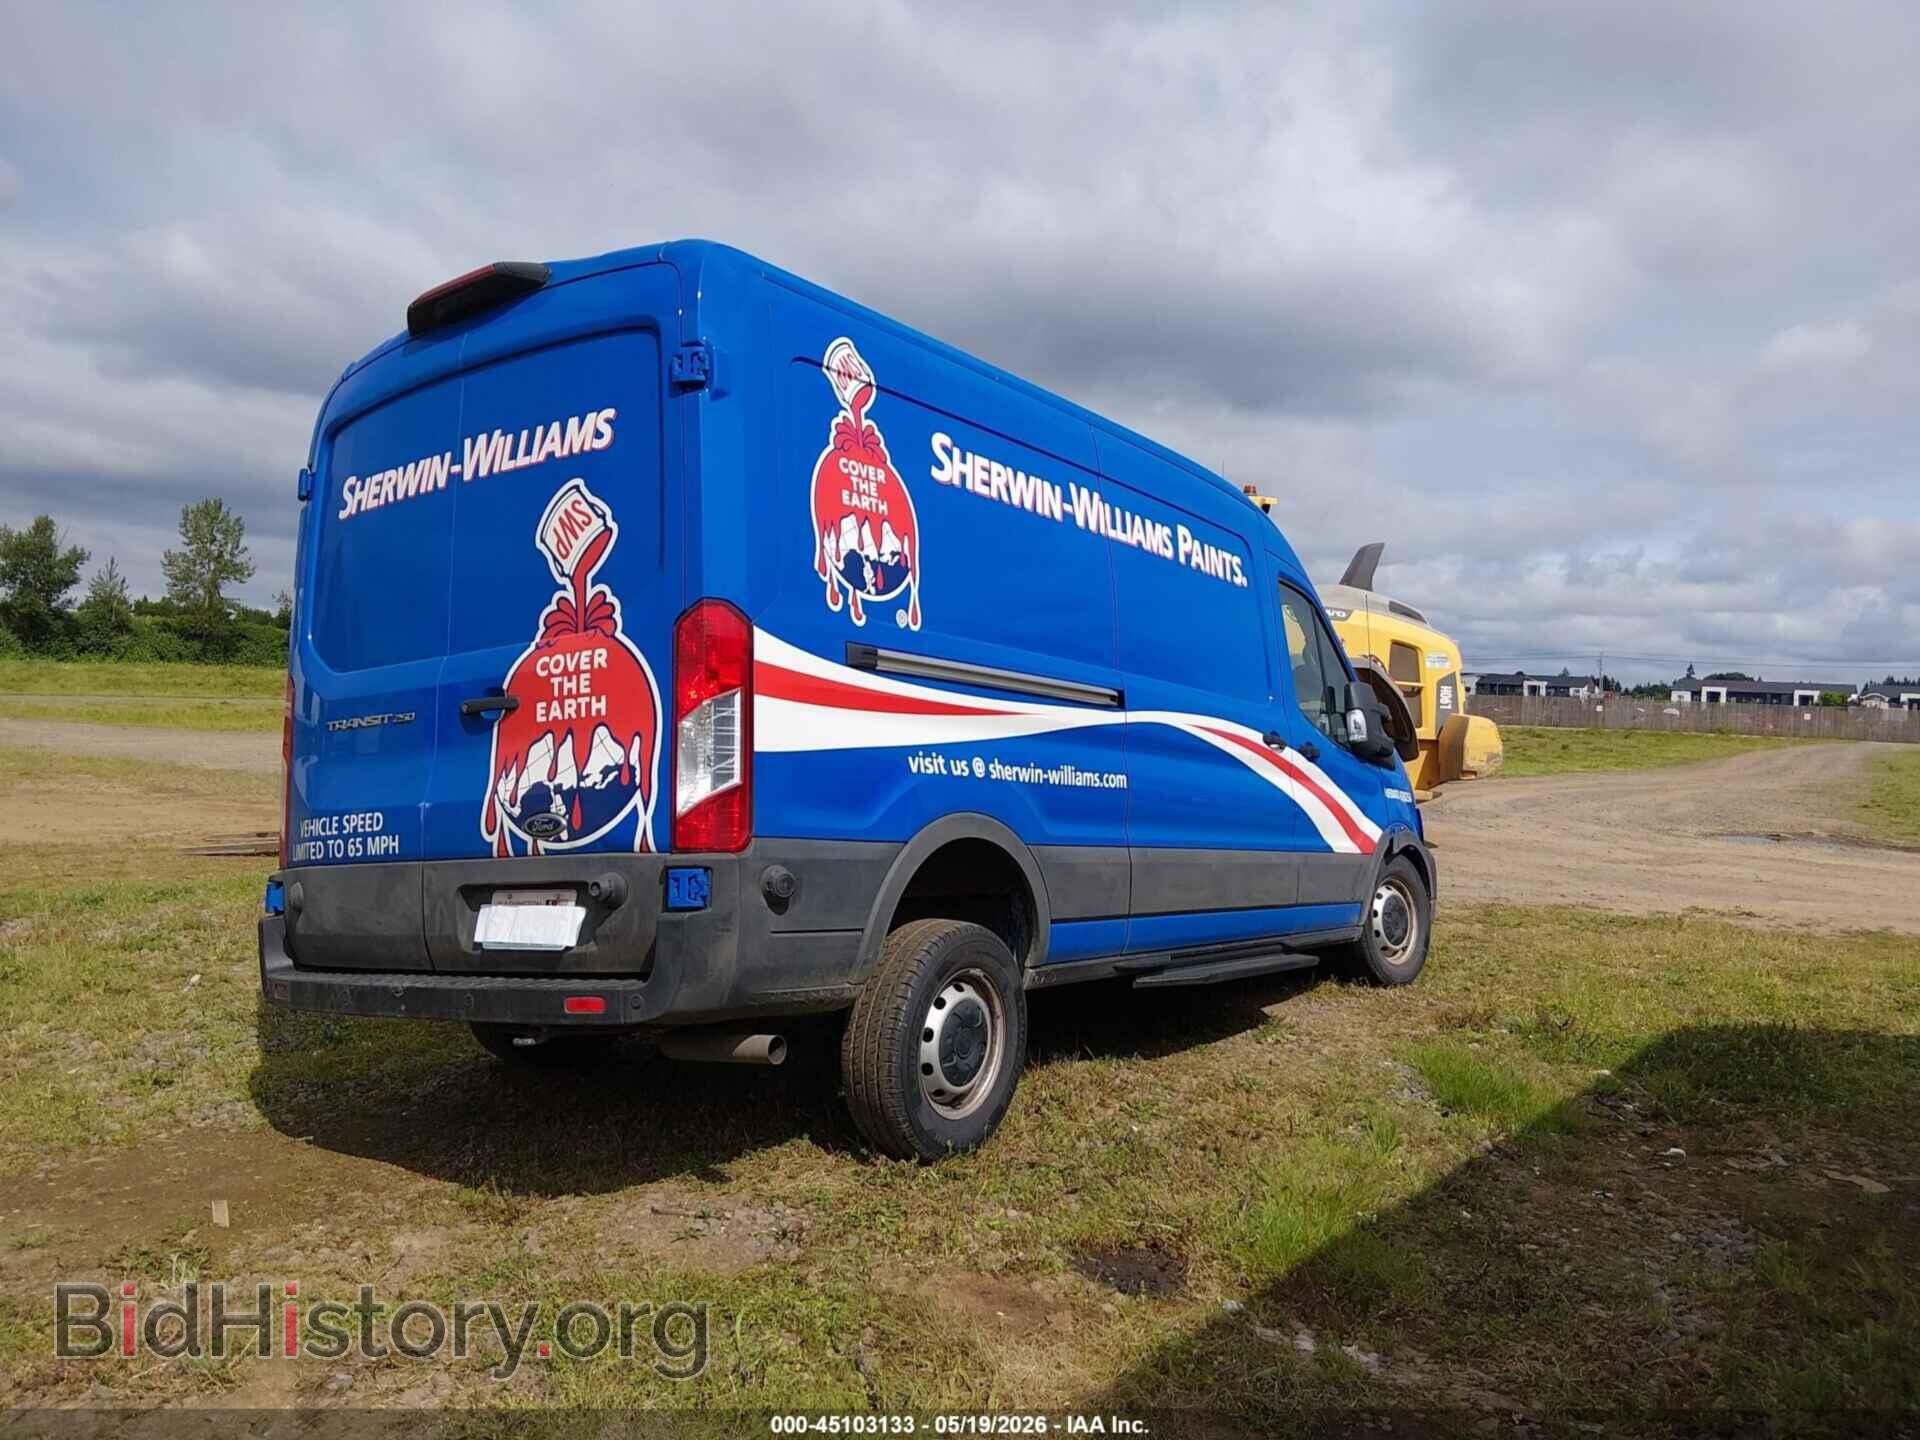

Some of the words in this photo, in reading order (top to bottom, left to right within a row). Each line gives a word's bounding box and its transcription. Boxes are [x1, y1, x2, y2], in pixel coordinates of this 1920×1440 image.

[338, 408, 617, 520] SHERWIN-WILLIAMS
[838, 457, 887, 485] COVER
[850, 475, 879, 497] THE
[841, 492, 889, 515] EARTH
[930, 432, 1174, 560] SHERWIN-WILLIAMS
[1177, 524, 1248, 588] PAINTS.
[552, 499, 593, 561] SWP
[536, 648, 608, 677] COVER
[550, 673, 592, 697] THE
[1439, 685, 1452, 709] L90H
[536, 695, 608, 722] EARTH
[327, 713, 393, 731] TRANSIT
[908, 751, 947, 775] visit
[950, 758, 970, 777] us
[972, 757, 986, 778] @
[988, 758, 1128, 789] sherwin-williams.com
[300, 816, 339, 838] VEHICLE
[342, 812, 383, 834] SPEED
[326, 839, 345, 858] TO
[347, 837, 363, 858] 65
[367, 834, 399, 856] MPH
